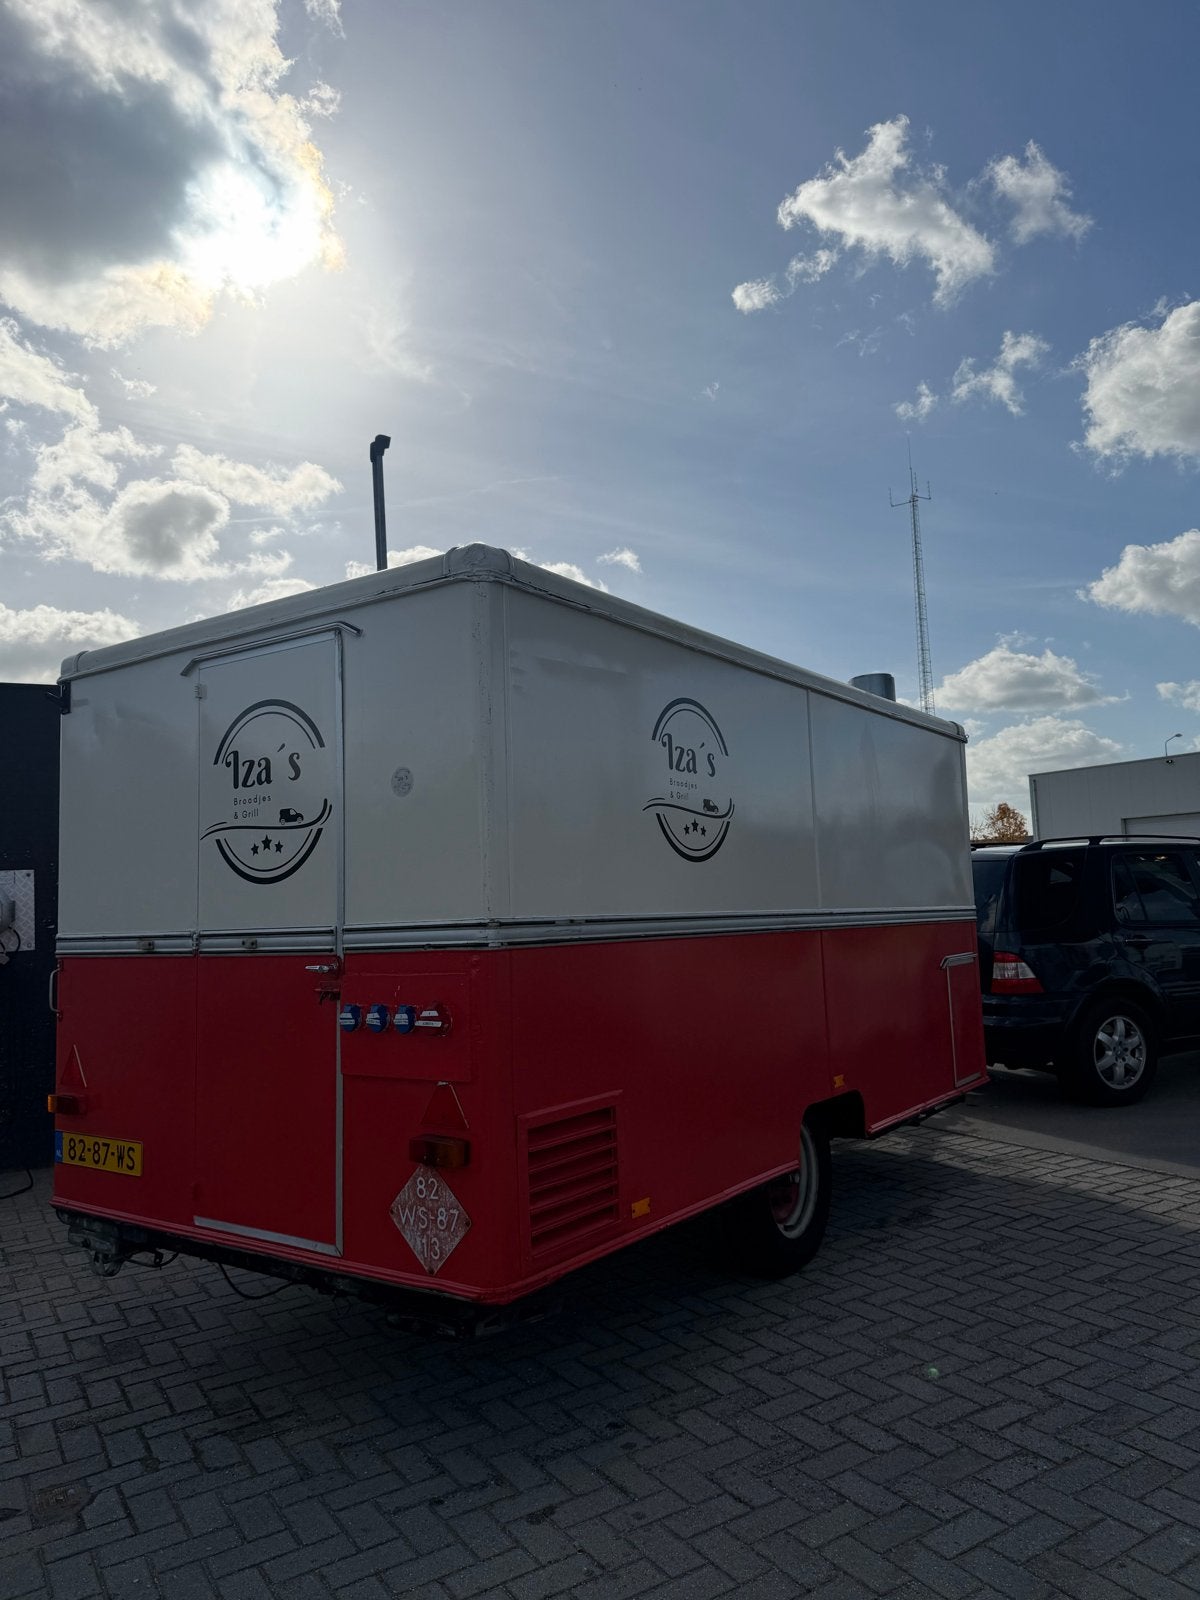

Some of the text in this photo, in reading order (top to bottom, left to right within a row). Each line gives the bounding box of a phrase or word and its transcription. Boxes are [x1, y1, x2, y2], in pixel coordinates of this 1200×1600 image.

[233, 794, 272, 806] Broodjes
[233, 808, 259, 820] & Grill
[68, 1138, 136, 1171] 82-87-WS
[416, 1177, 439, 1200] 82
[398, 1204, 460, 1233] WS-87
[421, 1234, 440, 1260] 13
